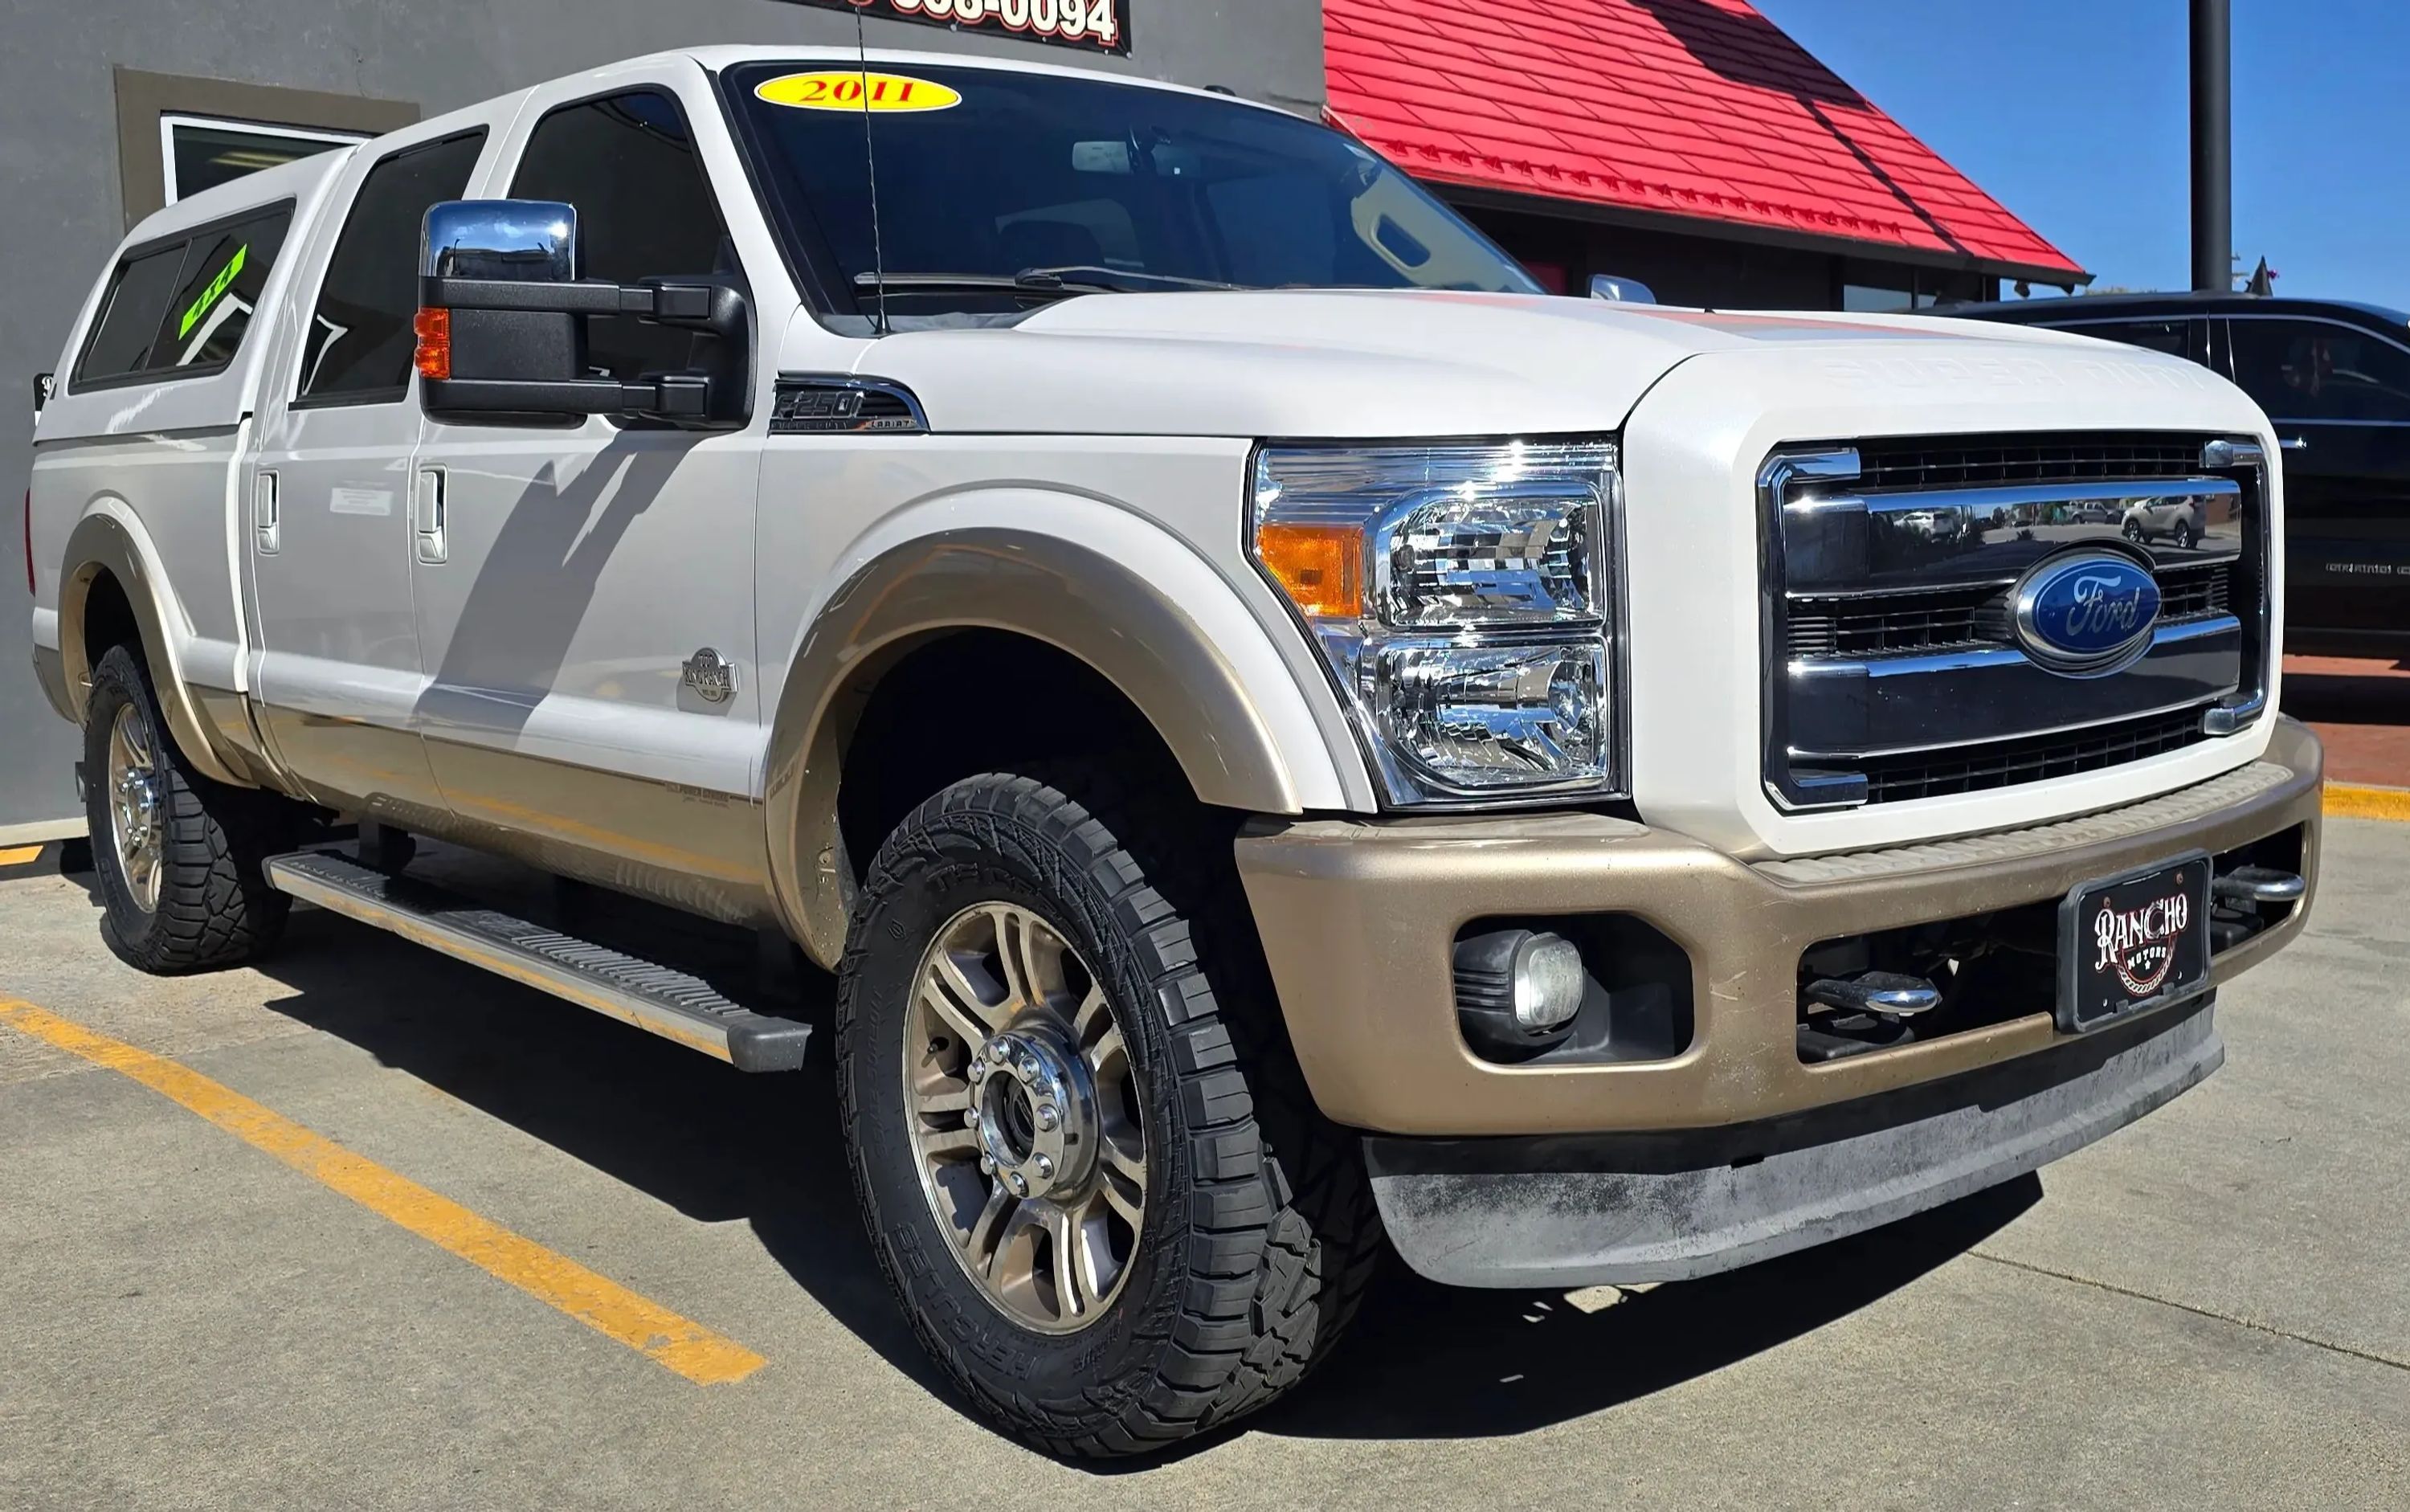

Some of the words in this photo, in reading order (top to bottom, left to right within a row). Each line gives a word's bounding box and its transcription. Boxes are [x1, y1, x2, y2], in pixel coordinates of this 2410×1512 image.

[799, 80, 913, 101] 2011
[872, 419, 910, 428] LARIAT
[2066, 575, 2140, 636] Ford
[2094, 893, 2188, 971] RANCHO
[2127, 946, 2167, 970] MOTORS
[893, 1222, 1038, 1381] HERCULES
